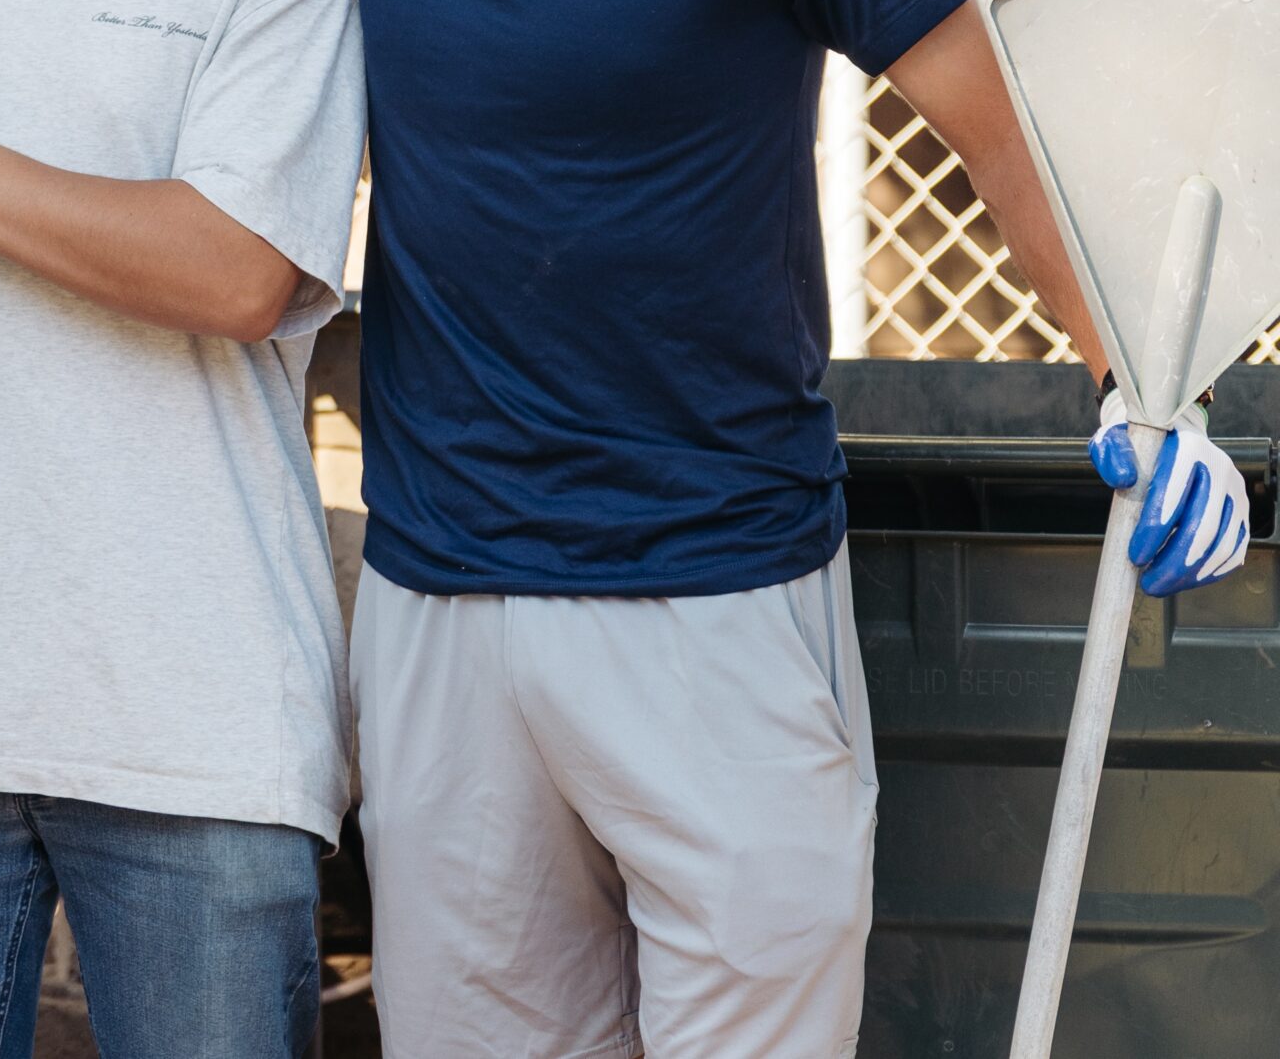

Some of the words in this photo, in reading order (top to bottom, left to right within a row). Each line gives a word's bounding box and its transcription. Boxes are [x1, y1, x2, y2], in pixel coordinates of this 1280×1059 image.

[91, 11, 126, 26] Better
[127, 15, 163, 31] Than
[161, 21, 209, 42] Yesterda
[959, 669, 1056, 697] BEFORE
